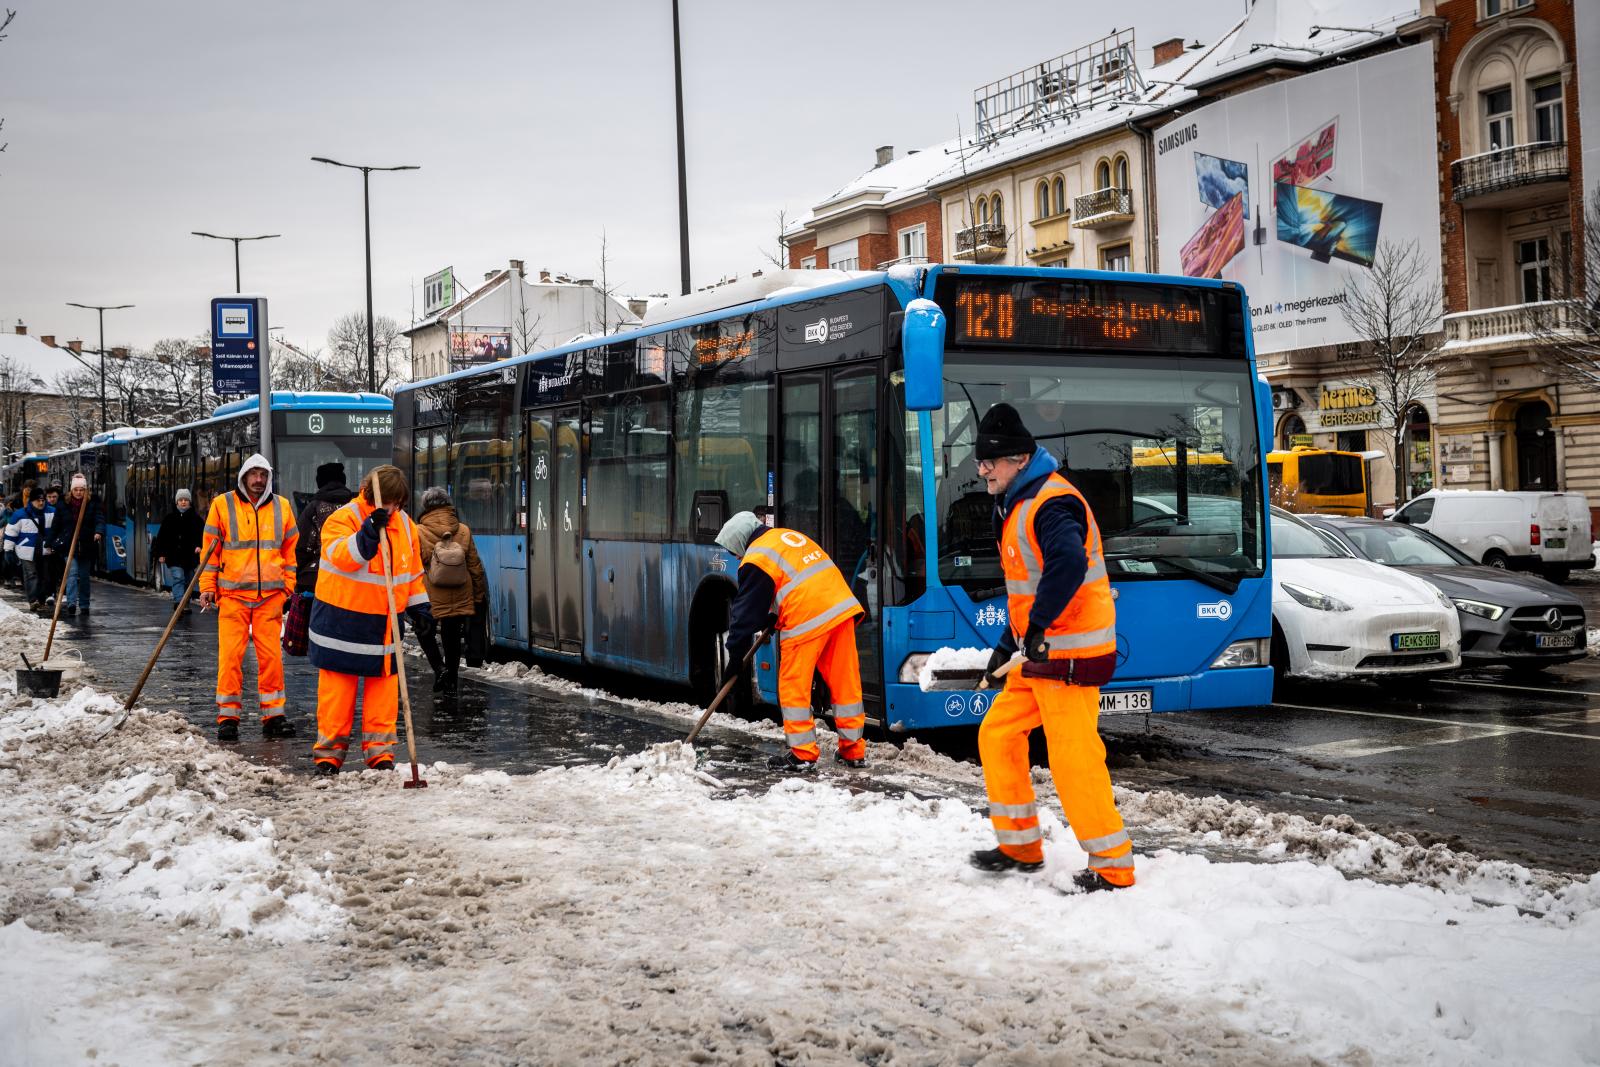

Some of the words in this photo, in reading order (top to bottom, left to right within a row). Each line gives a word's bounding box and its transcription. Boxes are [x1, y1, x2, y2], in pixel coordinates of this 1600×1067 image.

[1158, 123, 1198, 155] SAMSUNG
[1264, 304, 1273, 315] AI
[1284, 292, 1347, 313] megérkezett
[1278, 320, 1293, 329] OLED
[1295, 318, 1306, 326] The
[1307, 316, 1327, 325] Frame
[808, 328, 818, 337] BKK
[1320, 384, 1376, 410] hermes
[1320, 409, 1381, 426] KERTÉSZBOLT
[1201, 607, 1217, 615] BKK
